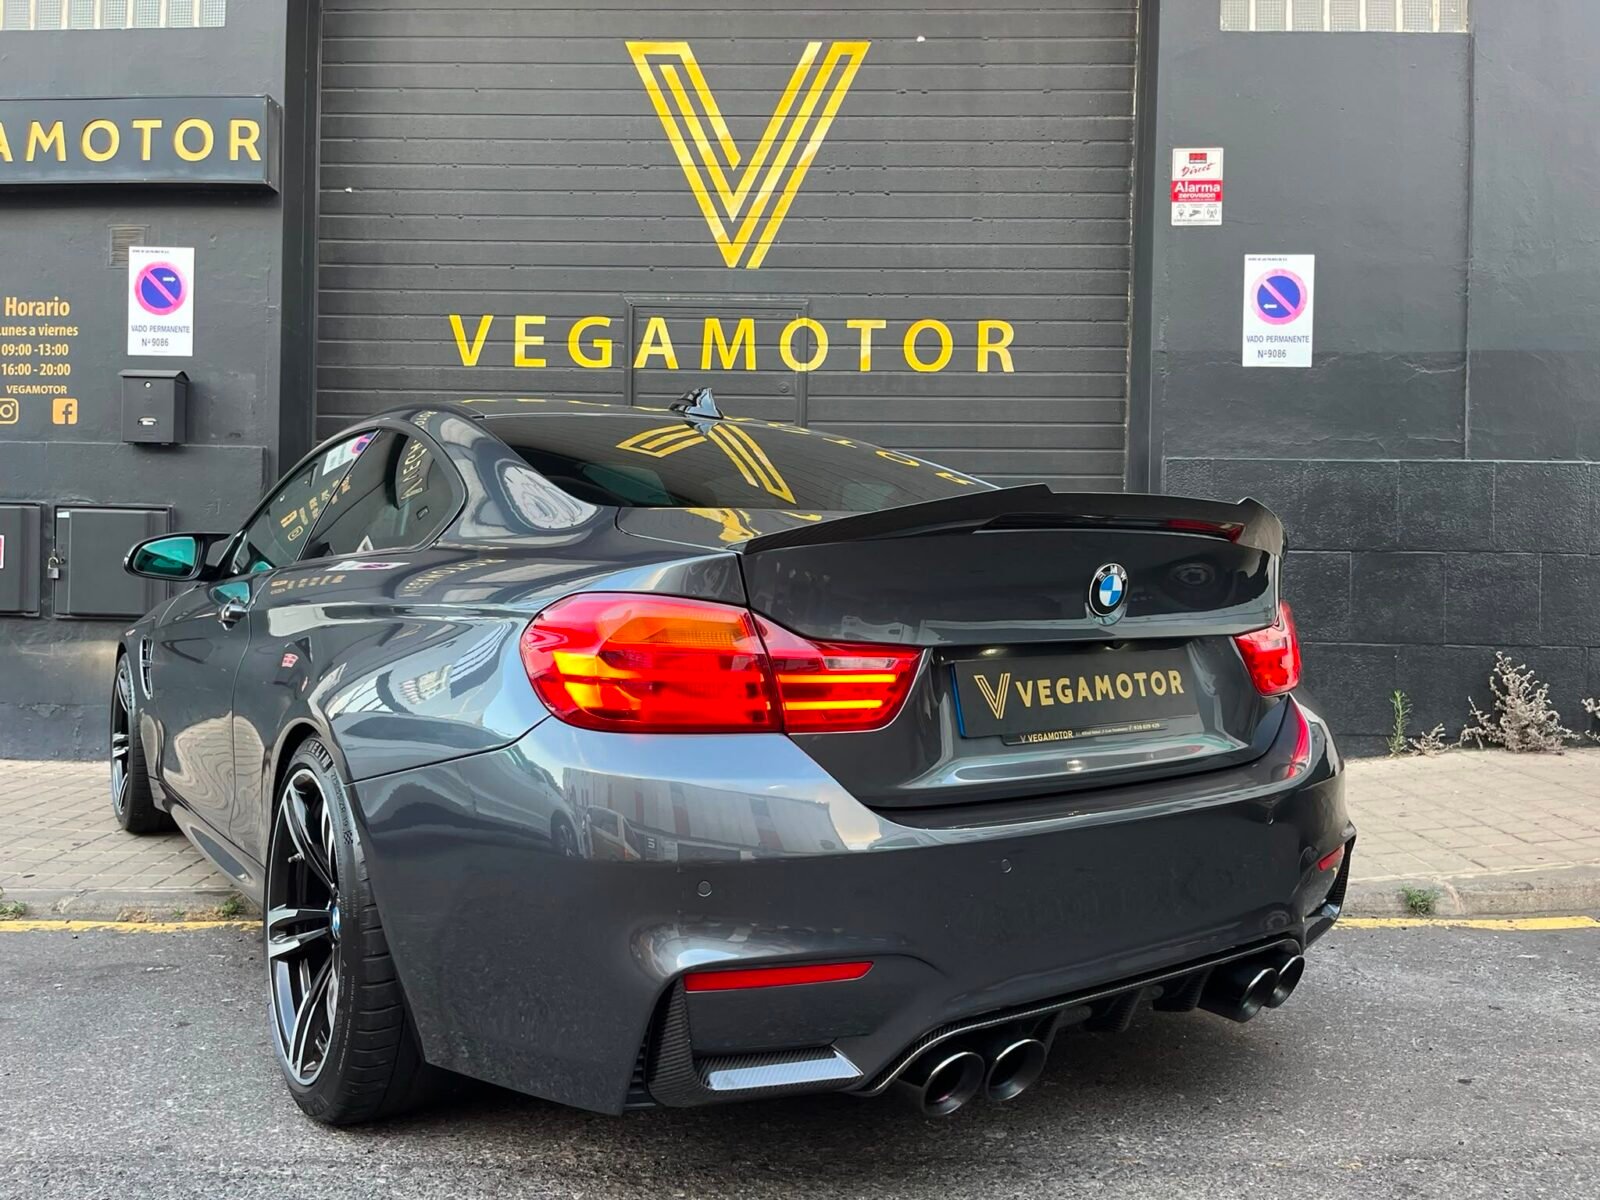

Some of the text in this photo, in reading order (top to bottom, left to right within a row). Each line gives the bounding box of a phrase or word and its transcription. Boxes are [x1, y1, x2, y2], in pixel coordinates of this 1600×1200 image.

[1175, 181, 1220, 192] Alarma
[4, 296, 71, 317] Horario
[28, 327, 36, 337] a
[38, 323, 79, 337] viernes
[131, 324, 191, 334] VADO PERMANENTE
[449, 314, 1015, 373] VEGAMOTOR
[1246, 335, 1310, 344] VADO PERMANENTE
[1, 343, 32, 356] 09:00
[1, 363, 32, 376] 16:00
[39, 363, 71, 376] 20:00
[6, 384, 68, 395] VEGAMOTOR
[1015, 670, 1185, 708] VEGAMOTOR
[1028, 730, 1073, 743] VEGAMOTOR
